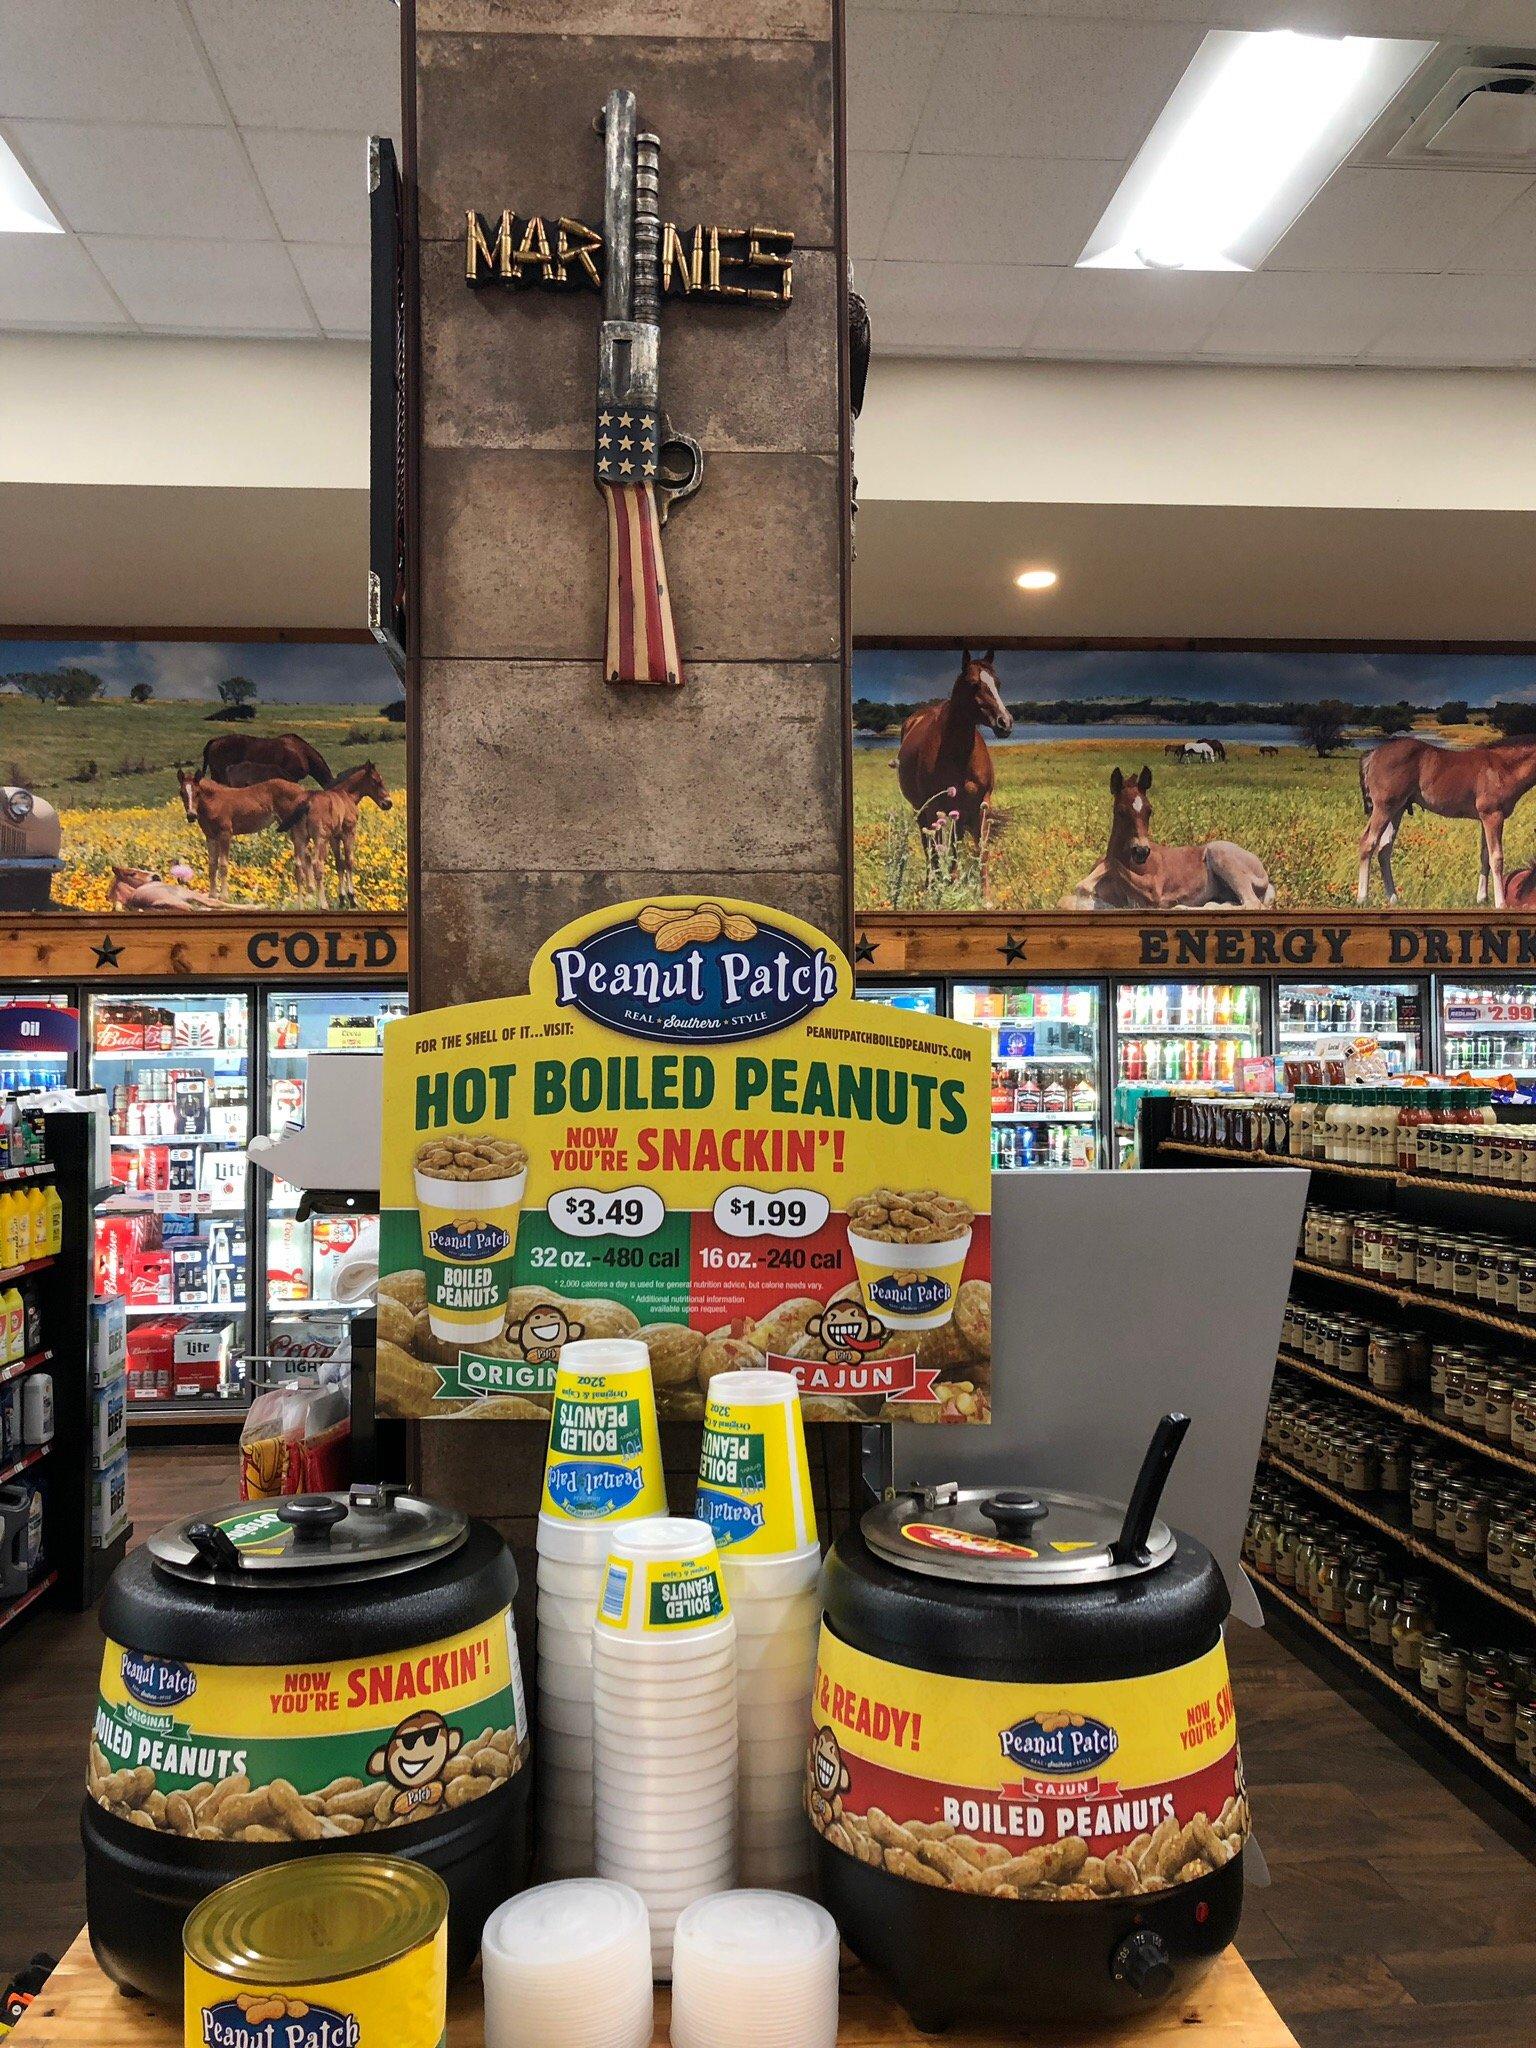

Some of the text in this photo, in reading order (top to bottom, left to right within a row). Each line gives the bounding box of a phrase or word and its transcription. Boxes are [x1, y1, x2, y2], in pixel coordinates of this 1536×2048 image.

[247, 932, 397, 968] COLD
[1138, 929, 1351, 964] ENERGY
[556, 950, 836, 1004] Peanut Patch
[624, 1009, 768, 1029] REAL Southern STYLE
[1488, 1006, 1532, 1020] $2.99
[20, 1021, 41, 1037] Oil
[415, 1038, 437, 1054] FOR
[441, 1034, 462, 1050] THE
[466, 1029, 498, 1046] SHELL
[502, 1027, 516, 1041] OF
[806, 1025, 972, 1062] PEANUTPATCHBOILEDPEANUTS.COM
[415, 1055, 968, 1135] HOT BOILED PEANUTS
[566, 1127, 619, 1148] NOW
[550, 1150, 628, 1172] YOU'RE
[637, 1128, 845, 1173] SNACKIN'!
[215, 1162, 245, 1181] Lite
[566, 1197, 643, 1226] $3.49
[731, 1198, 807, 1226] $1.99
[429, 1231, 510, 1250] Peanut Patch
[530, 1247, 557, 1267] 32
[649, 1247, 680, 1267] cal
[699, 1248, 723, 1268] 16
[811, 1248, 842, 1269] cal
[443, 1267, 493, 1288] BOILED
[581, 1280, 608, 1288] calories
[637, 1280, 654, 1288] used
[666, 1281, 692, 1290] general
[693, 1281, 722, 1289] nutrition
[748, 1281, 760, 1289] but
[785, 1281, 806, 1289] needs
[437, 1285, 499, 1307] PEANUTS
[635, 1295, 745, 1304] Additional nutritional information
[869, 1283, 951, 1303] Peanut Patch
[650, 1305, 680, 1313] available
[681, 1306, 698, 1314] upon
[183, 1341, 210, 1356] Lite
[285, 1362, 322, 1373] LIGH
[789, 1366, 893, 1389] CAJUN
[577, 1375, 607, 1388] 32oz
[584, 1390, 591, 1398] &
[592, 1390, 628, 1400] Original
[559, 1403, 628, 1428] PEANUTS
[560, 1428, 617, 1453] BOILED
[585, 1467, 644, 1494] Peanut
[709, 1501, 765, 1526] Peanut
[661, 1575, 714, 1602] PEANUTS
[665, 1594, 711, 1619] BOILED
[121, 1653, 155, 1687] Peanut
[159, 1666, 197, 1696] Patch
[284, 1672, 331, 1693] NOW
[347, 1638, 491, 1708] SNACKIN'!
[270, 1691, 340, 1714] YOU'RE
[1186, 1700, 1210, 1727] NOW
[127, 1705, 171, 1729] ORIGINAL
[832, 1682, 922, 1752] READY!
[1000, 1728, 1118, 1757] Peanut Patch
[1179, 1717, 1217, 1751] YOU'RE
[137, 1737, 248, 1779] PEANUTS
[407, 1787, 431, 1806] Patch
[1034, 1781, 1088, 1796] CAJUN
[943, 1793, 1175, 1838] BOILED PEANUTS
[202, 2008, 360, 2048] Peanut Patch
